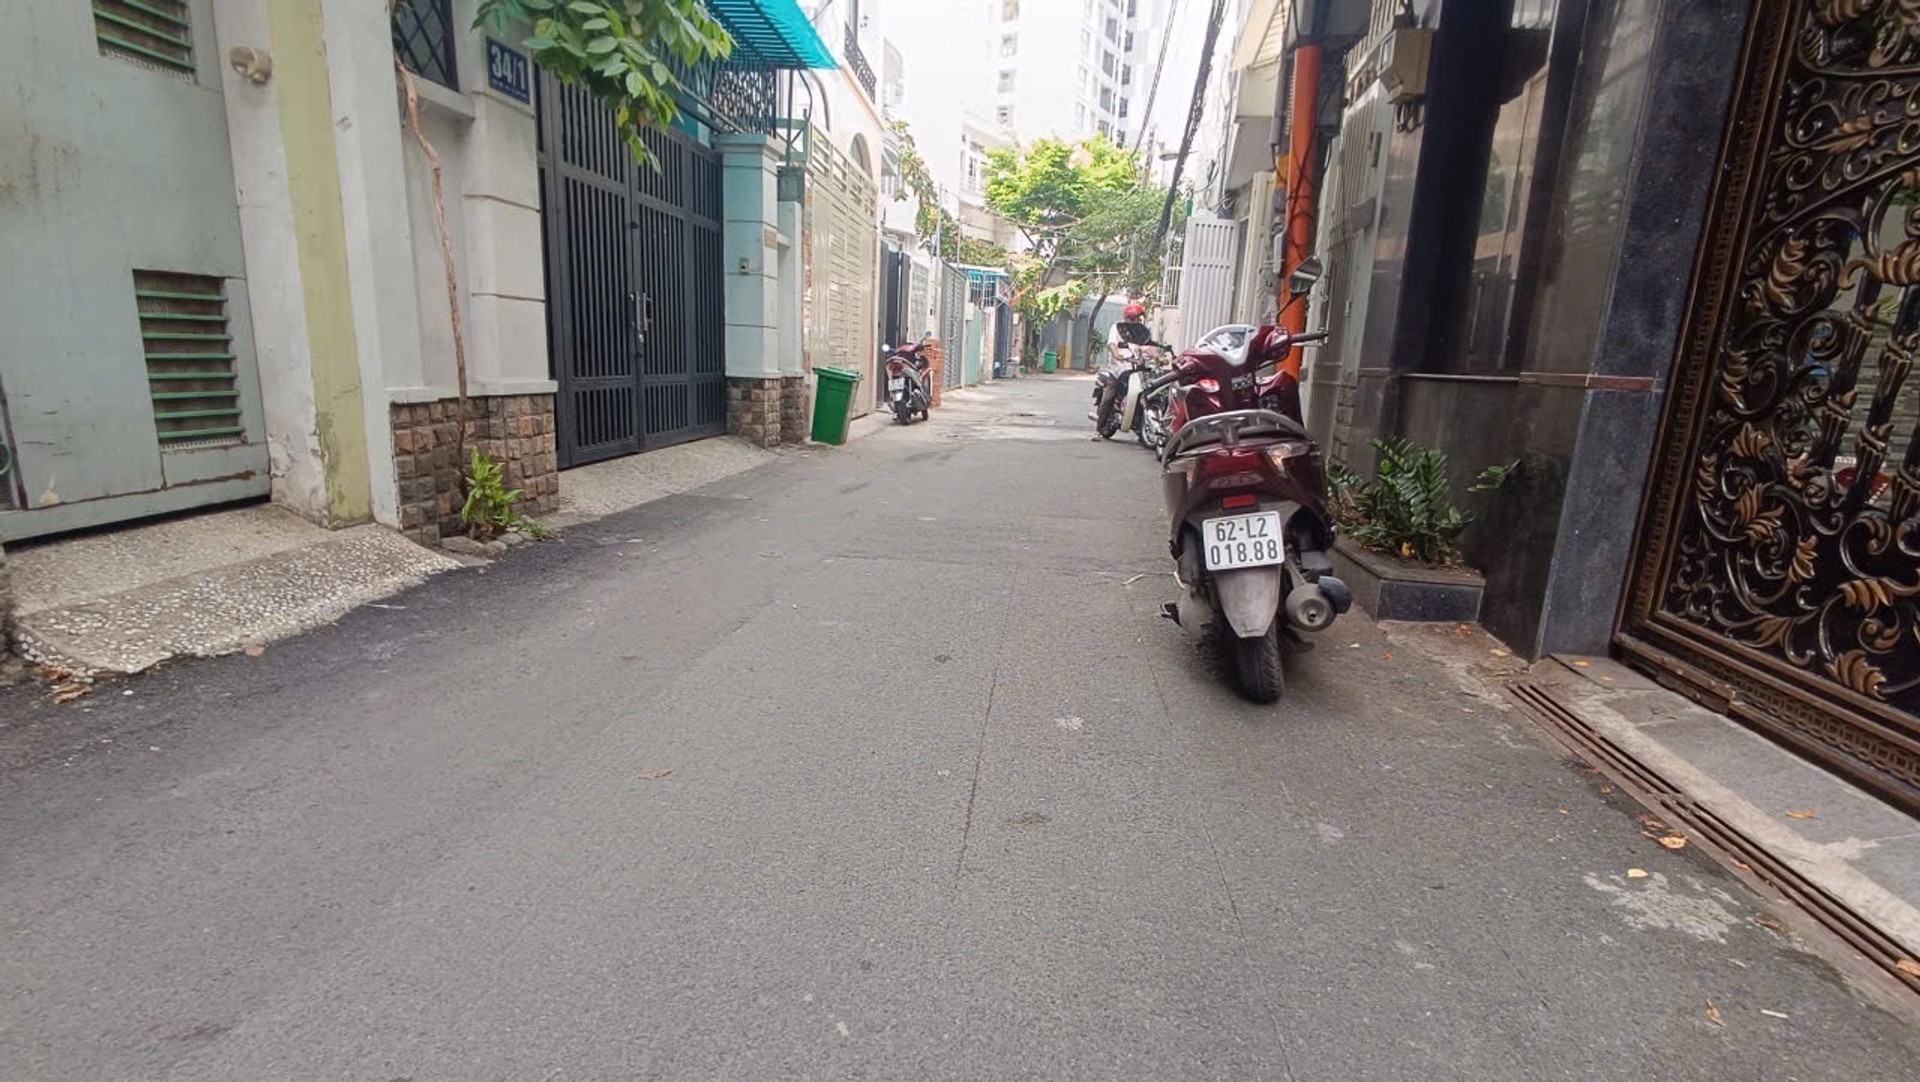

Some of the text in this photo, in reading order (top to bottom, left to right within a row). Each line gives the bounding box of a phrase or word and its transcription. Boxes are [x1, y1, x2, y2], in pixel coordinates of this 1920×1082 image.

[491, 45, 526, 90] 34/1
[1216, 518, 1268, 541] 62-L2
[1211, 539, 1278, 565] 018.88
